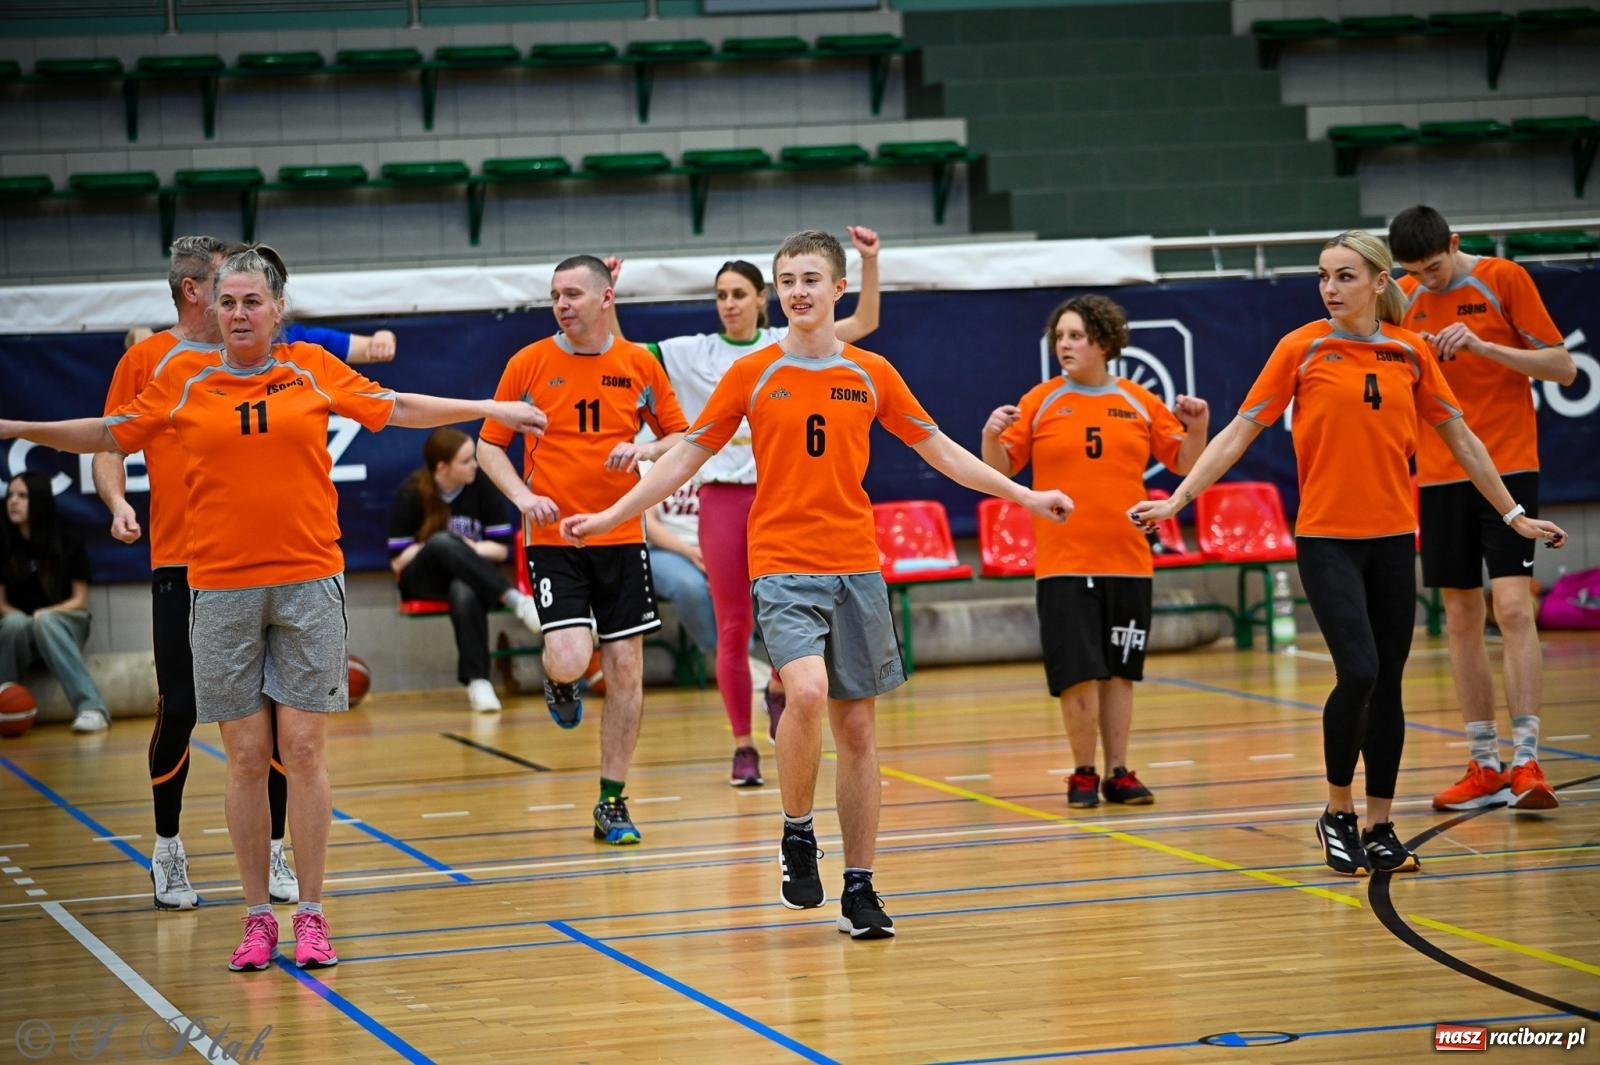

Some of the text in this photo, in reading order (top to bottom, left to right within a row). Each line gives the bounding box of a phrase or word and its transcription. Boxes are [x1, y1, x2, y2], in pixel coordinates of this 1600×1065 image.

[1457, 303, 1488, 316] ZSOMS
[601, 375, 632, 389] ZSOMS
[830, 387, 868, 403] ZSOMS
[1363, 373, 1383, 411] 4
[234, 400, 269, 436] 11
[574, 398, 600, 433] 11
[806, 413, 827, 458] 6
[1085, 426, 1103, 460] 5
[540, 577, 554, 609] 8
